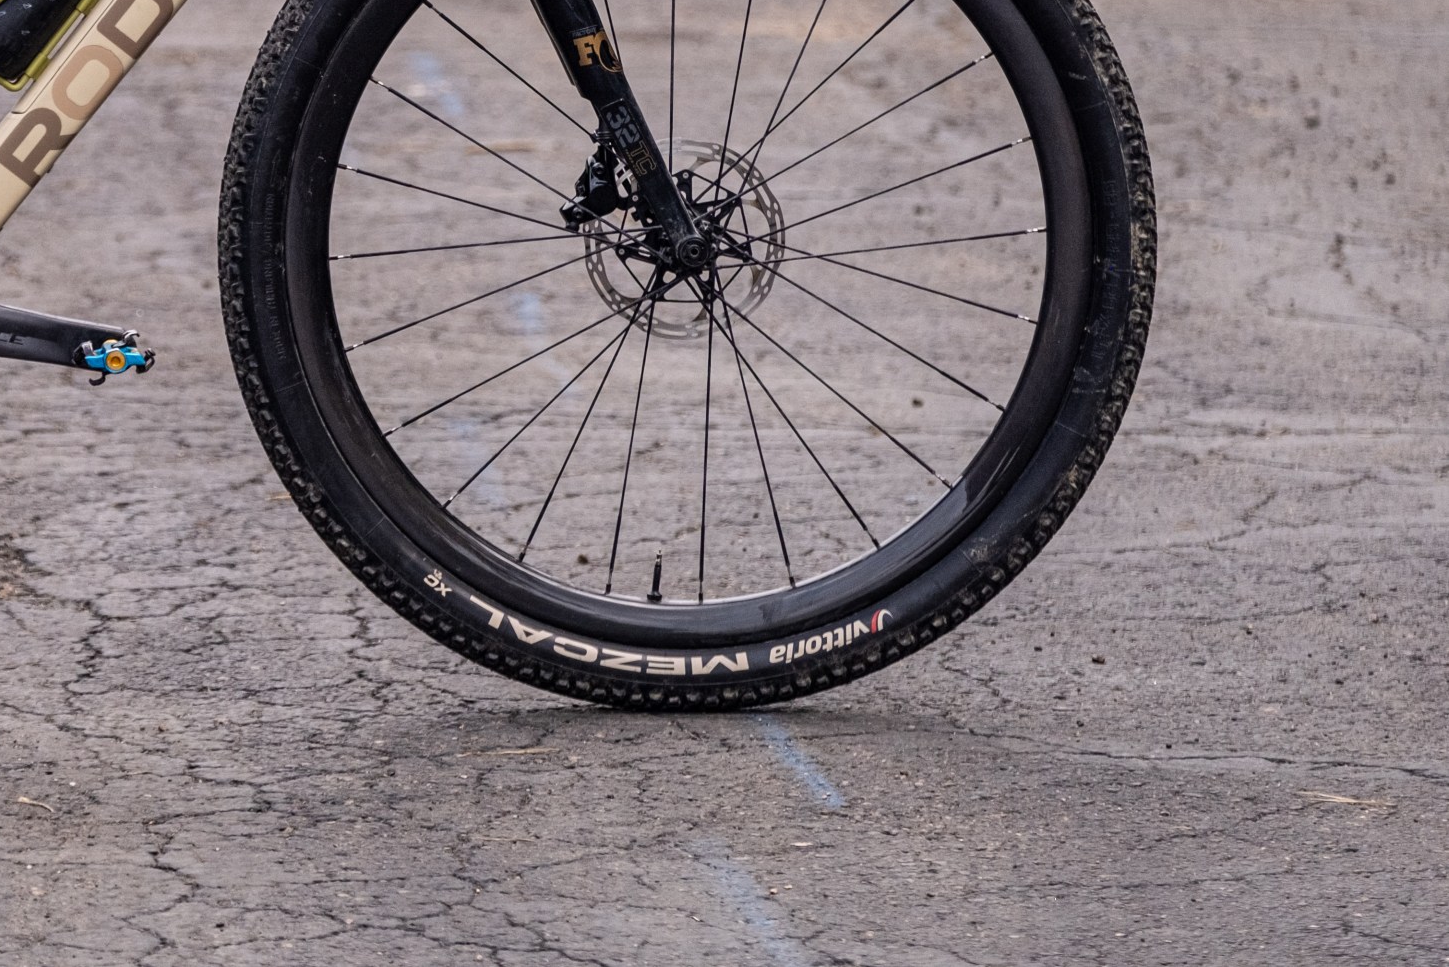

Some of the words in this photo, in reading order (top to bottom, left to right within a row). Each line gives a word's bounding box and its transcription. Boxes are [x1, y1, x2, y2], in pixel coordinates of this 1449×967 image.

[423, 574, 453, 597] XC
[470, 594, 749, 676] MEZCAL
[770, 619, 872, 664] vittoria
